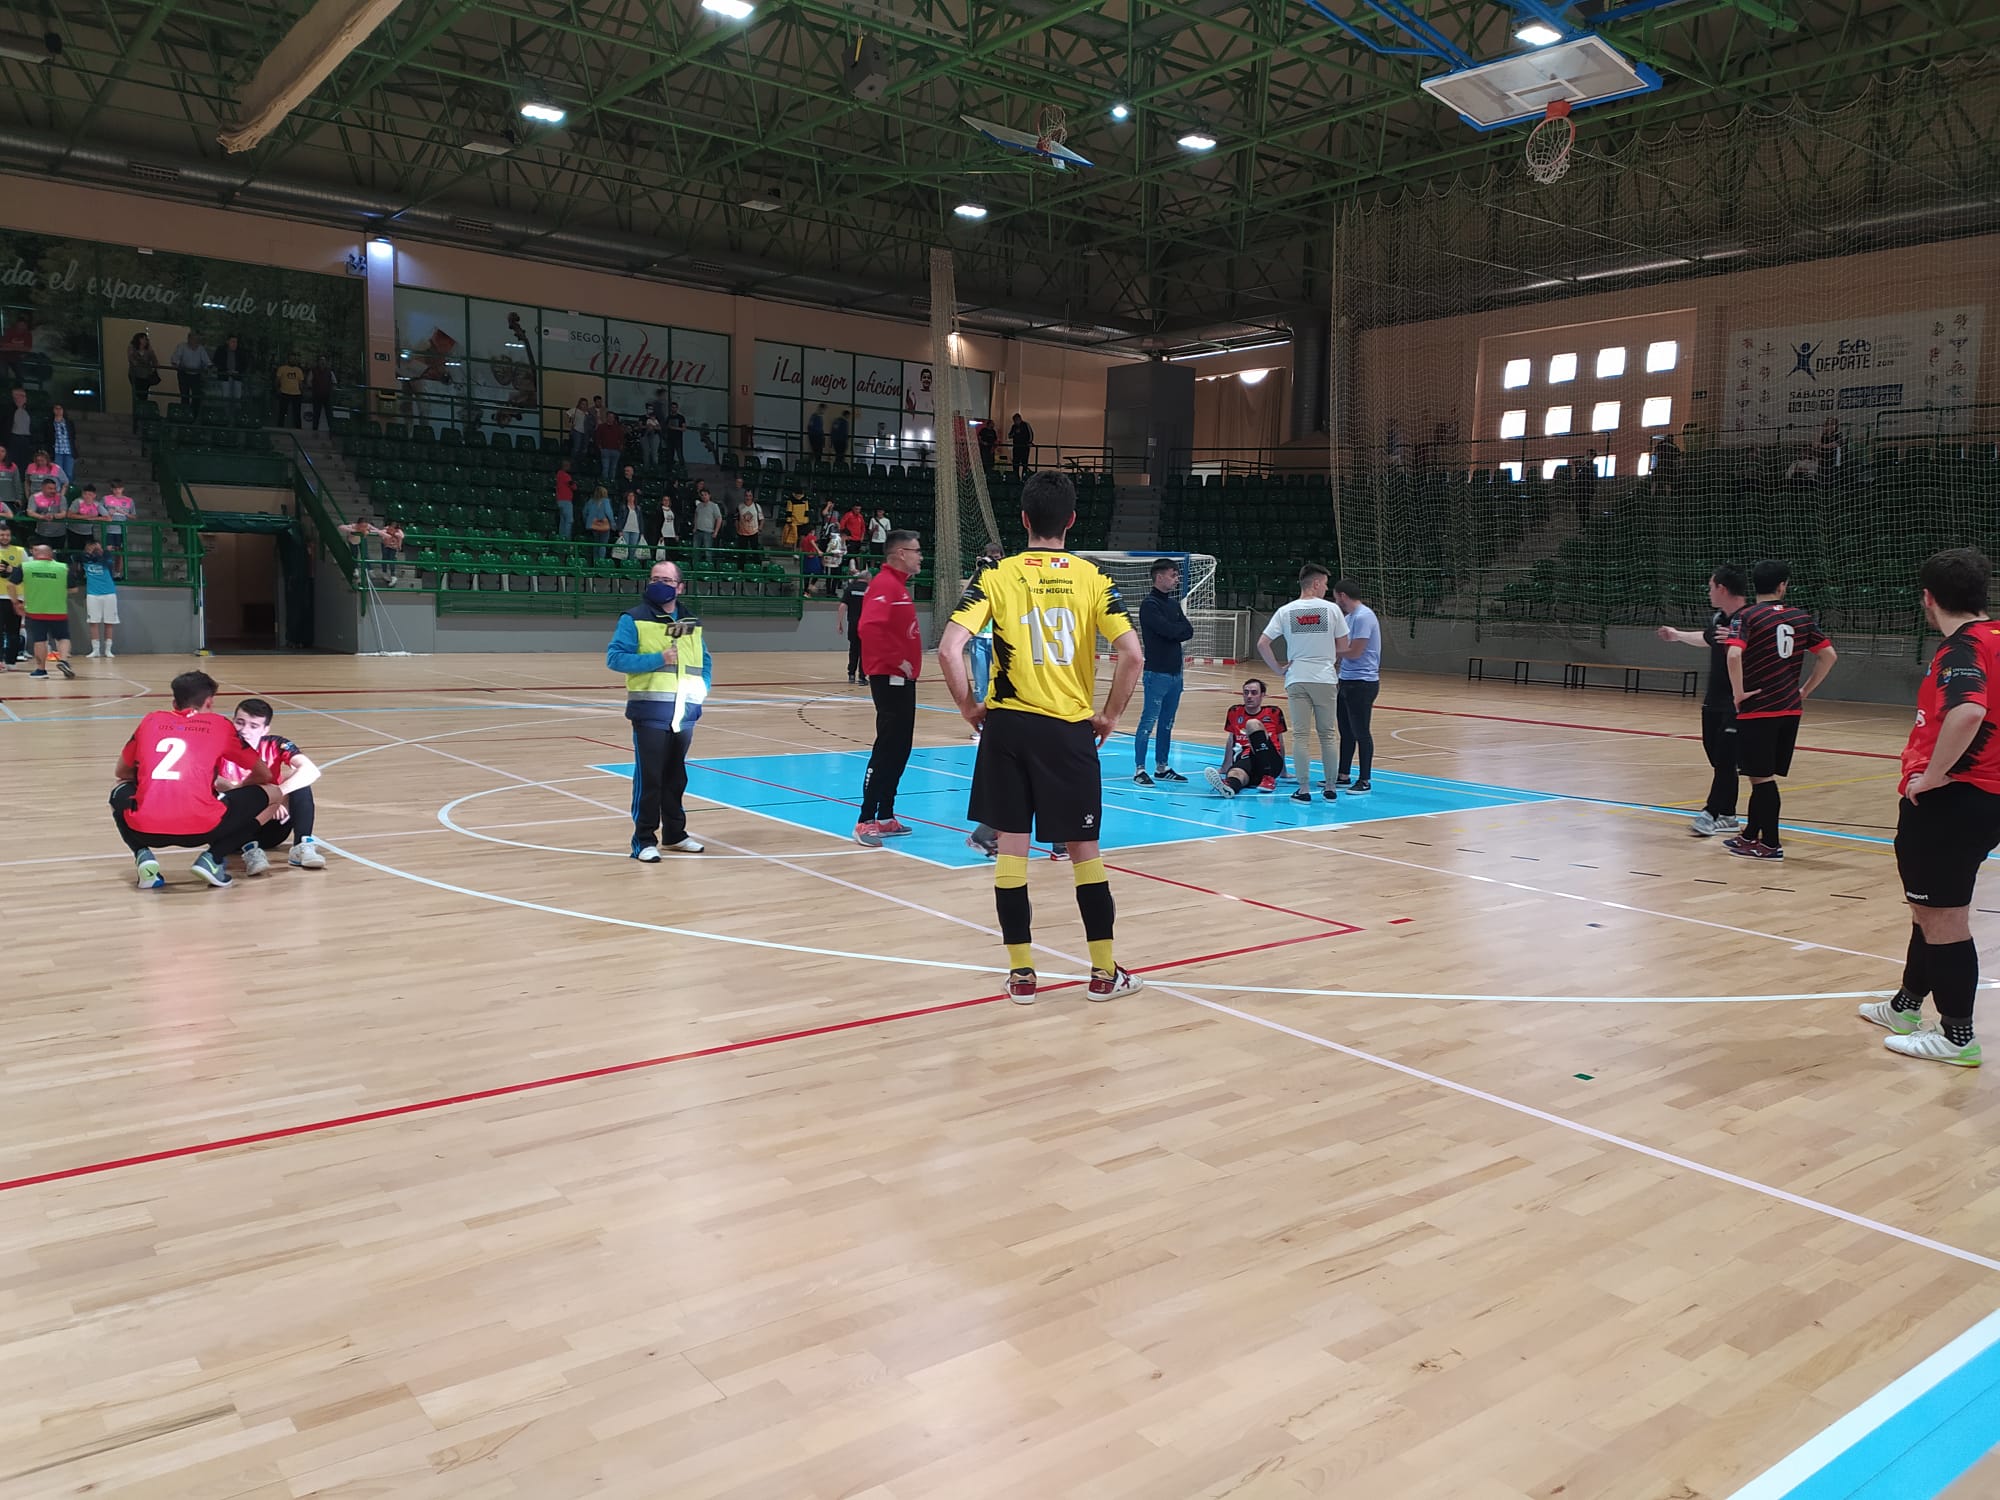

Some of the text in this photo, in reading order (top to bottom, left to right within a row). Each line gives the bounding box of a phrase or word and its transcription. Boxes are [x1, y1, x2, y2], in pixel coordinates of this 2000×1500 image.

[48, 259, 79, 292] el
[87, 275, 179, 309] espacio
[192, 281, 256, 315] donde
[266, 299, 317, 323] vives
[569, 330, 622, 346] SEGOVIA
[587, 328, 707, 384] cultura
[1815, 353, 1871, 373] DEPORTE
[810, 373, 849, 396] mejor
[855, 370, 902, 397] afición
[1019, 606, 1076, 667] 13
[1776, 623, 1795, 659] 6
[151, 737, 187, 780] 2
